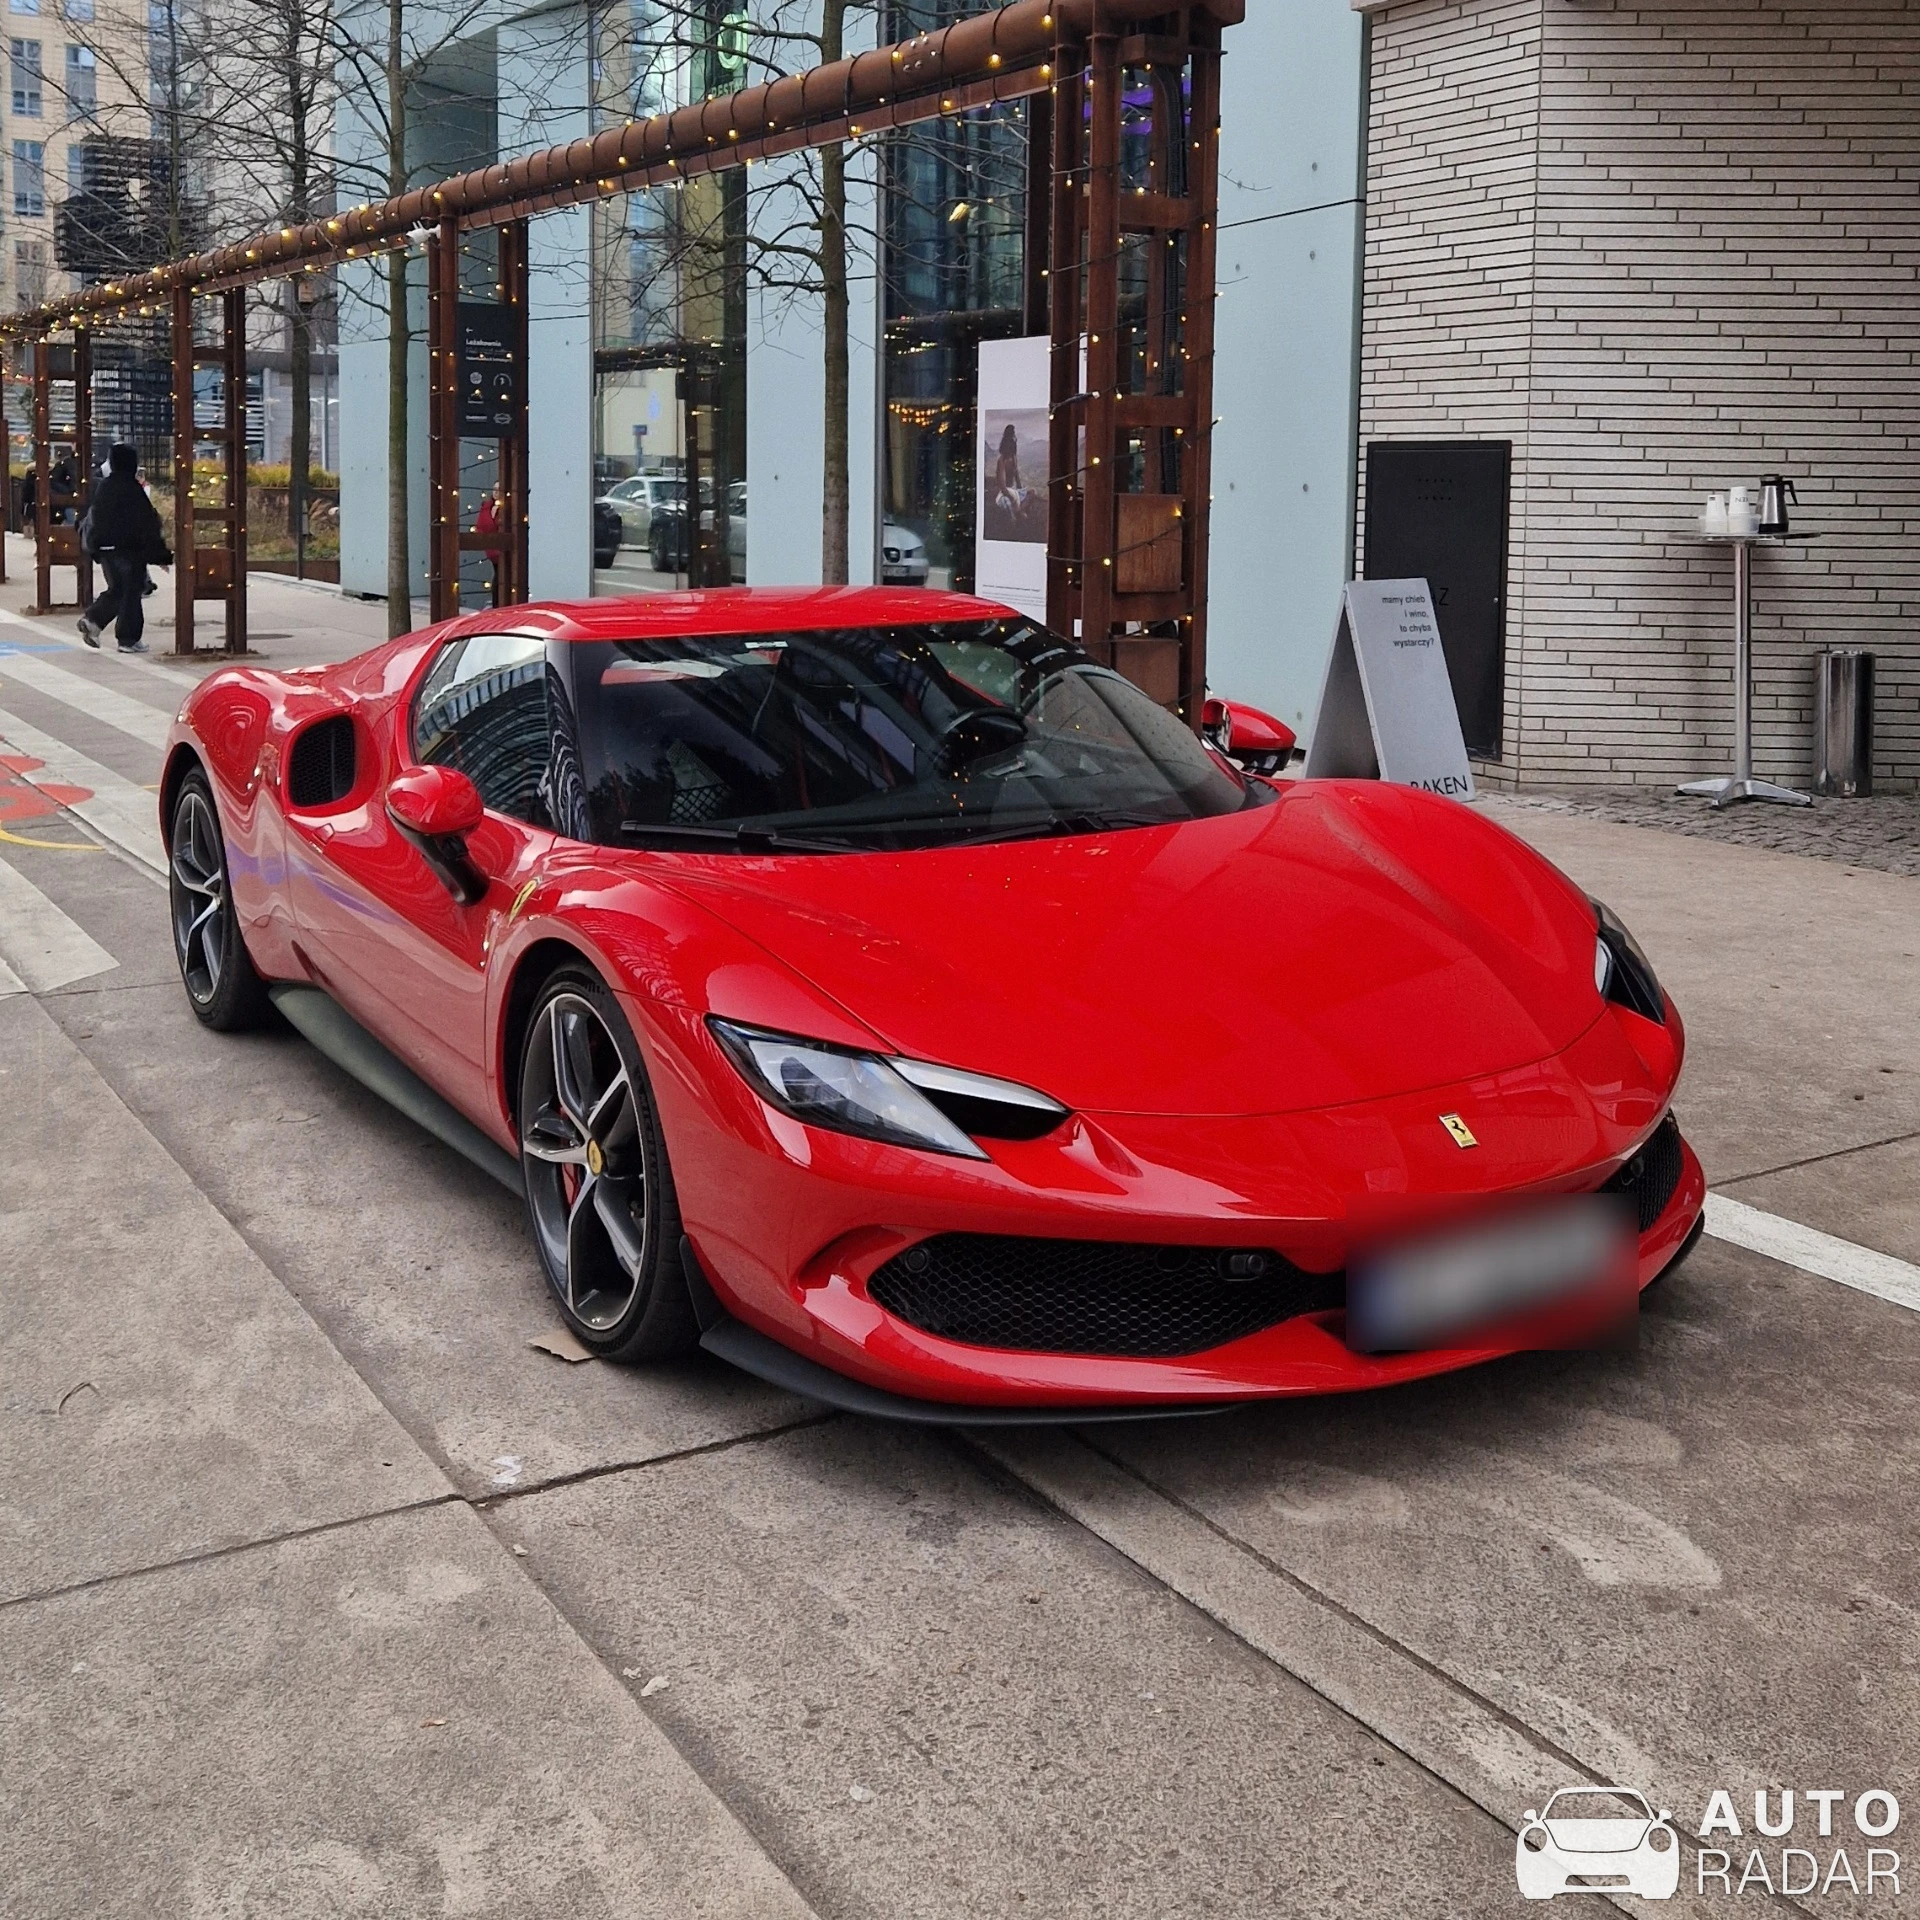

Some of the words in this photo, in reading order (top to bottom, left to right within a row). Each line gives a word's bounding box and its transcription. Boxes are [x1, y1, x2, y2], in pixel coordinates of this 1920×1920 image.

[1381, 596, 1404, 605] mamy
[1405, 594, 1426, 604] chleb
[1409, 610, 1430, 618] wino,
[1400, 624, 1408, 632] to
[1408, 624, 1432, 633] chyba
[1393, 637, 1435, 648] wystarczy?
